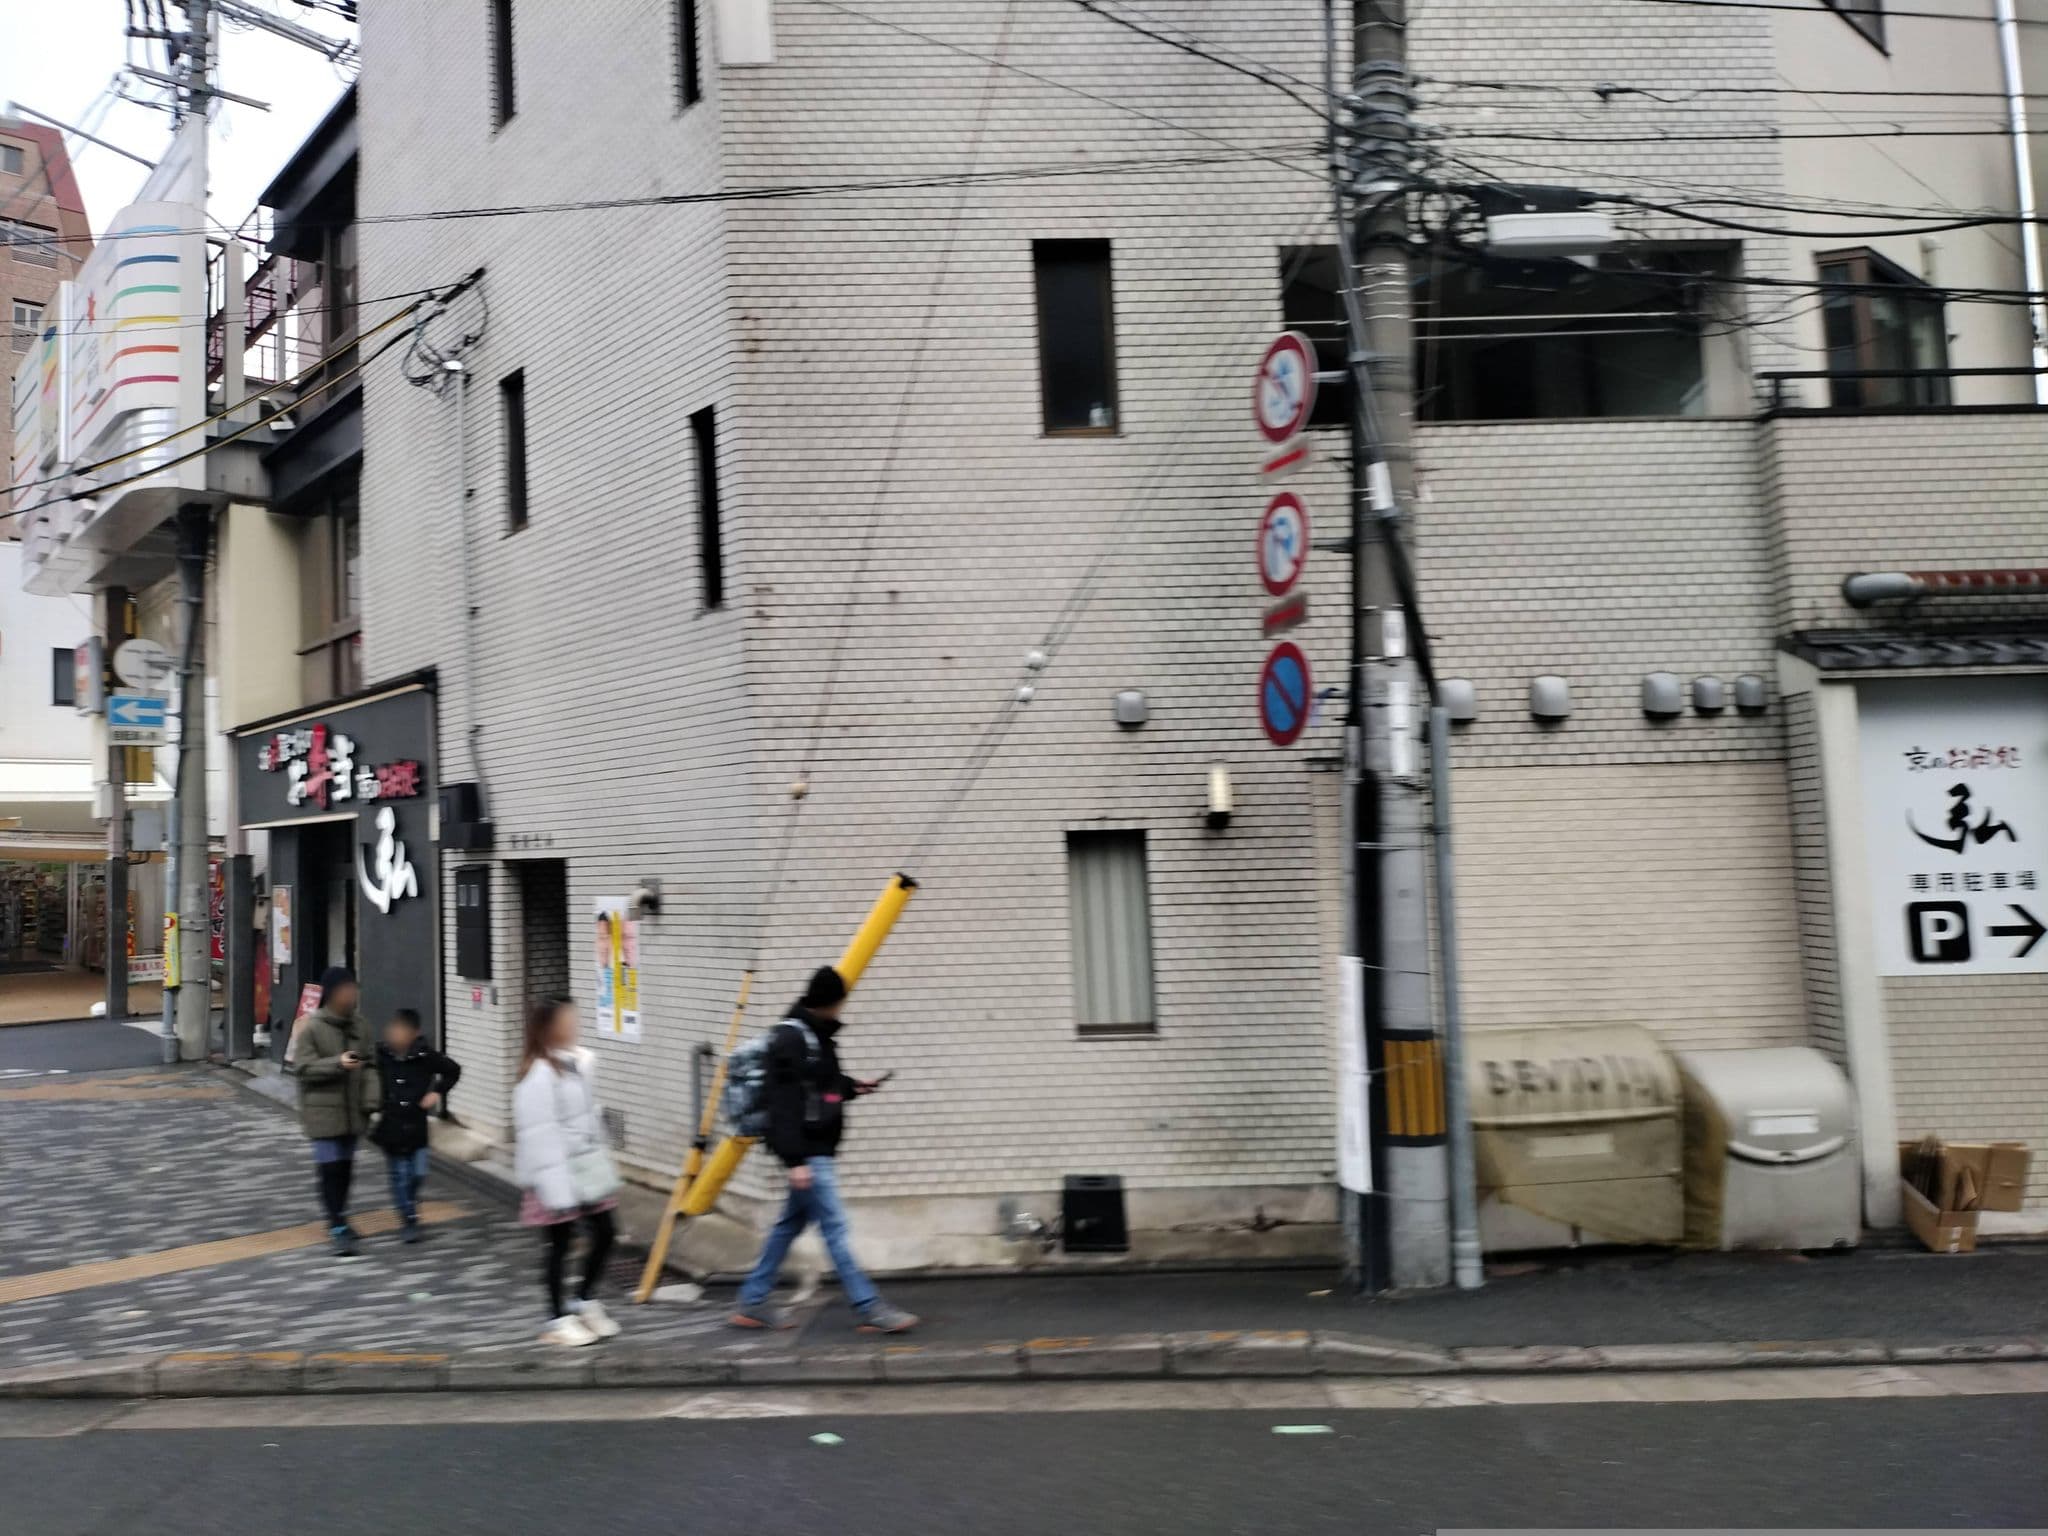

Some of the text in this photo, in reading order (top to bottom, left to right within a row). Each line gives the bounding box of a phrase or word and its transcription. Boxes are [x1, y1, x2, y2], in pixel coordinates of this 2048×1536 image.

[1905, 782, 2017, 854] 弘
[1908, 871, 2038, 893] 専用駐車場
[1919, 910, 1965, 957] P
